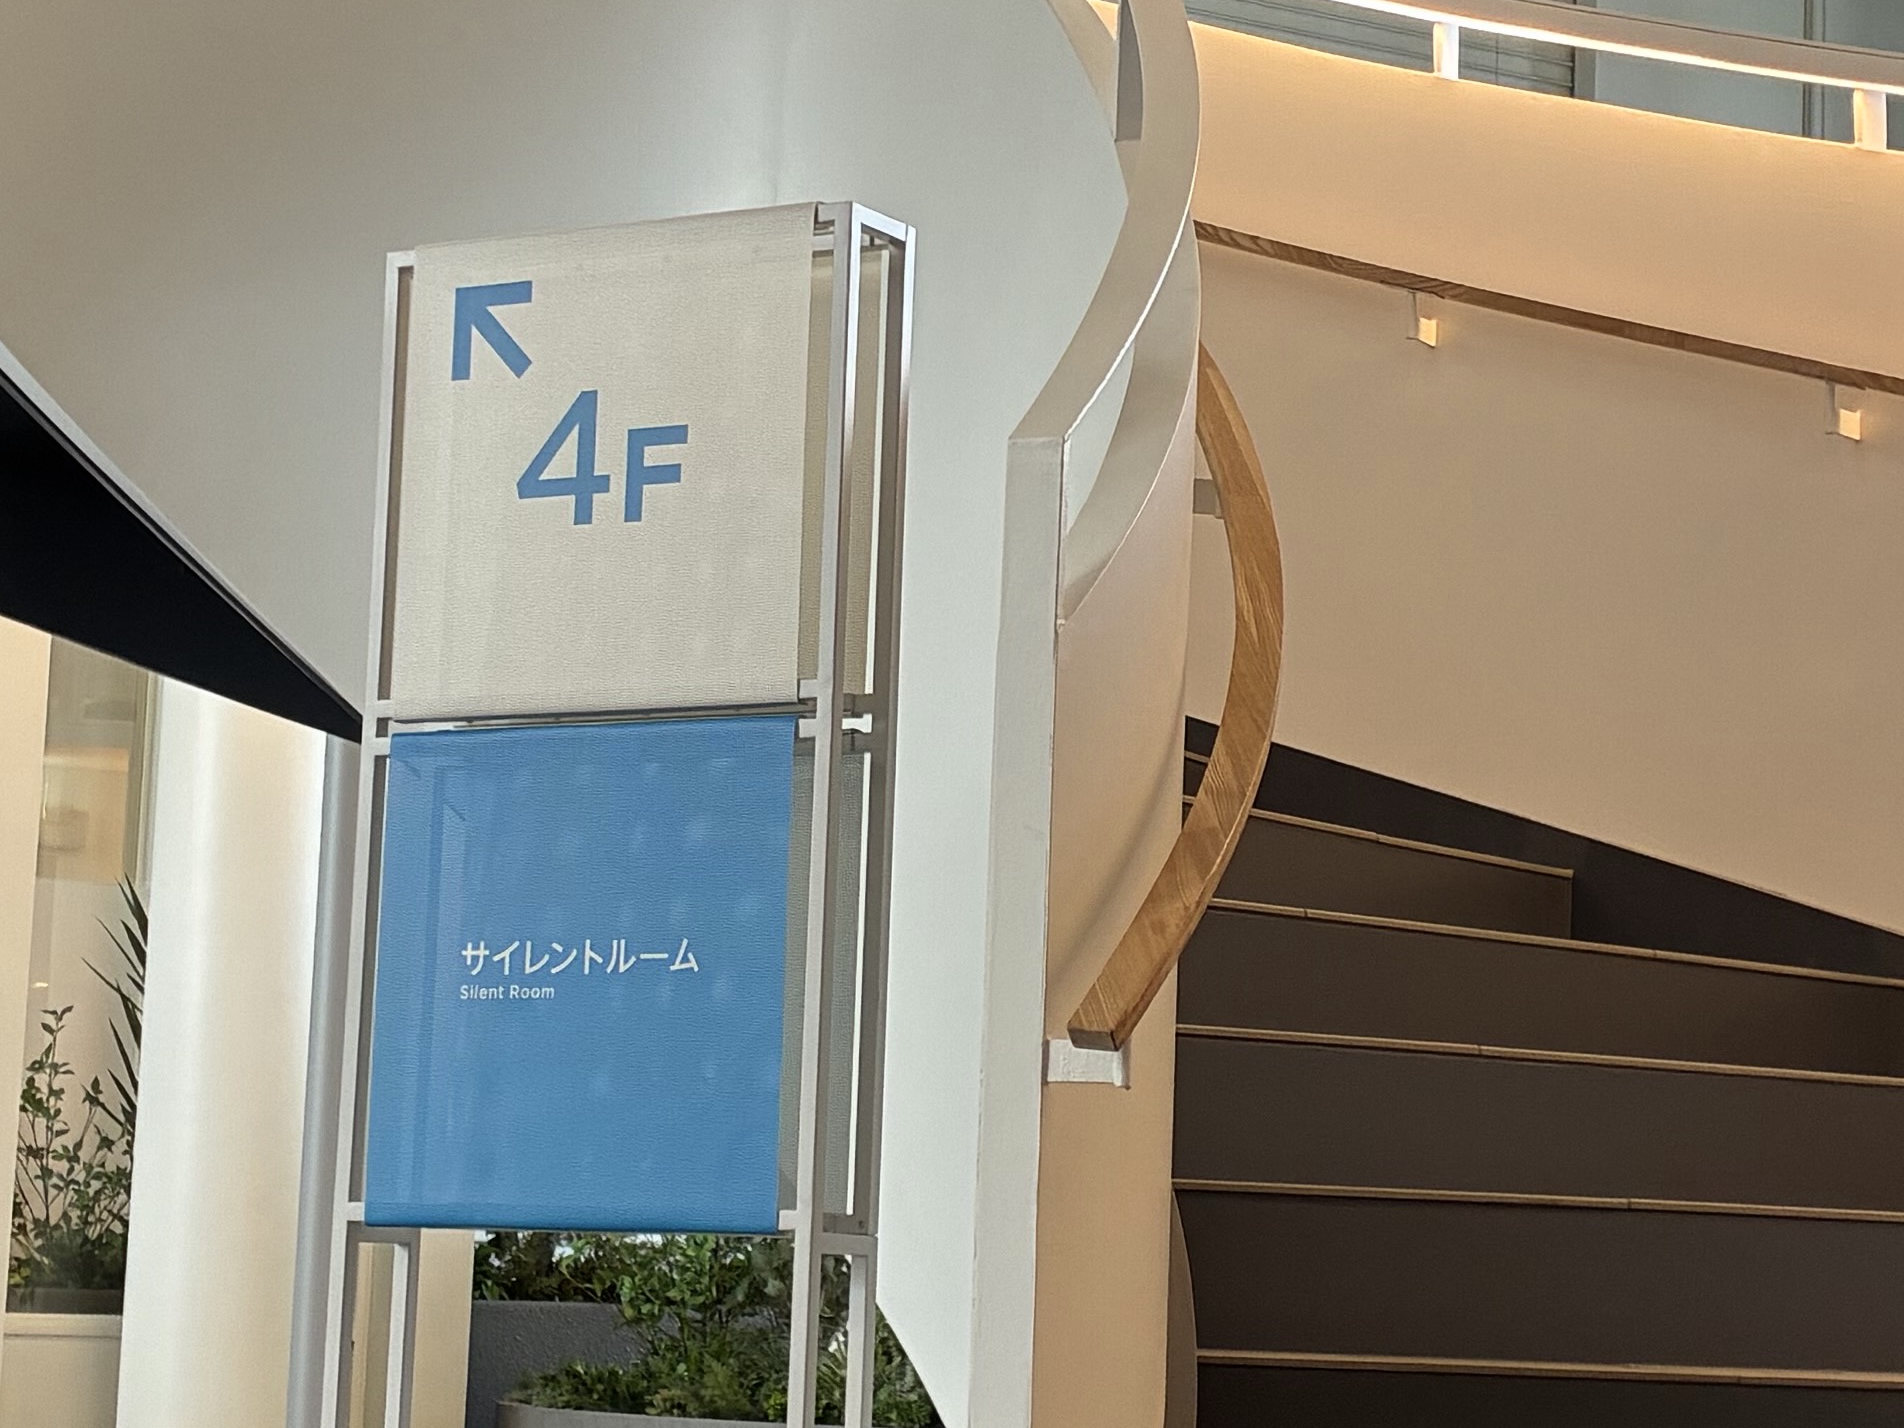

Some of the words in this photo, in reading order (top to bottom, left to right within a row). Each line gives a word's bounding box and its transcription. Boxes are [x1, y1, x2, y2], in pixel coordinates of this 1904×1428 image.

[516, 389, 688, 525] 4F
[461, 938, 699, 975] サイレントルーム
[459, 985, 504, 1000] Silent
[509, 984, 555, 999] Room
